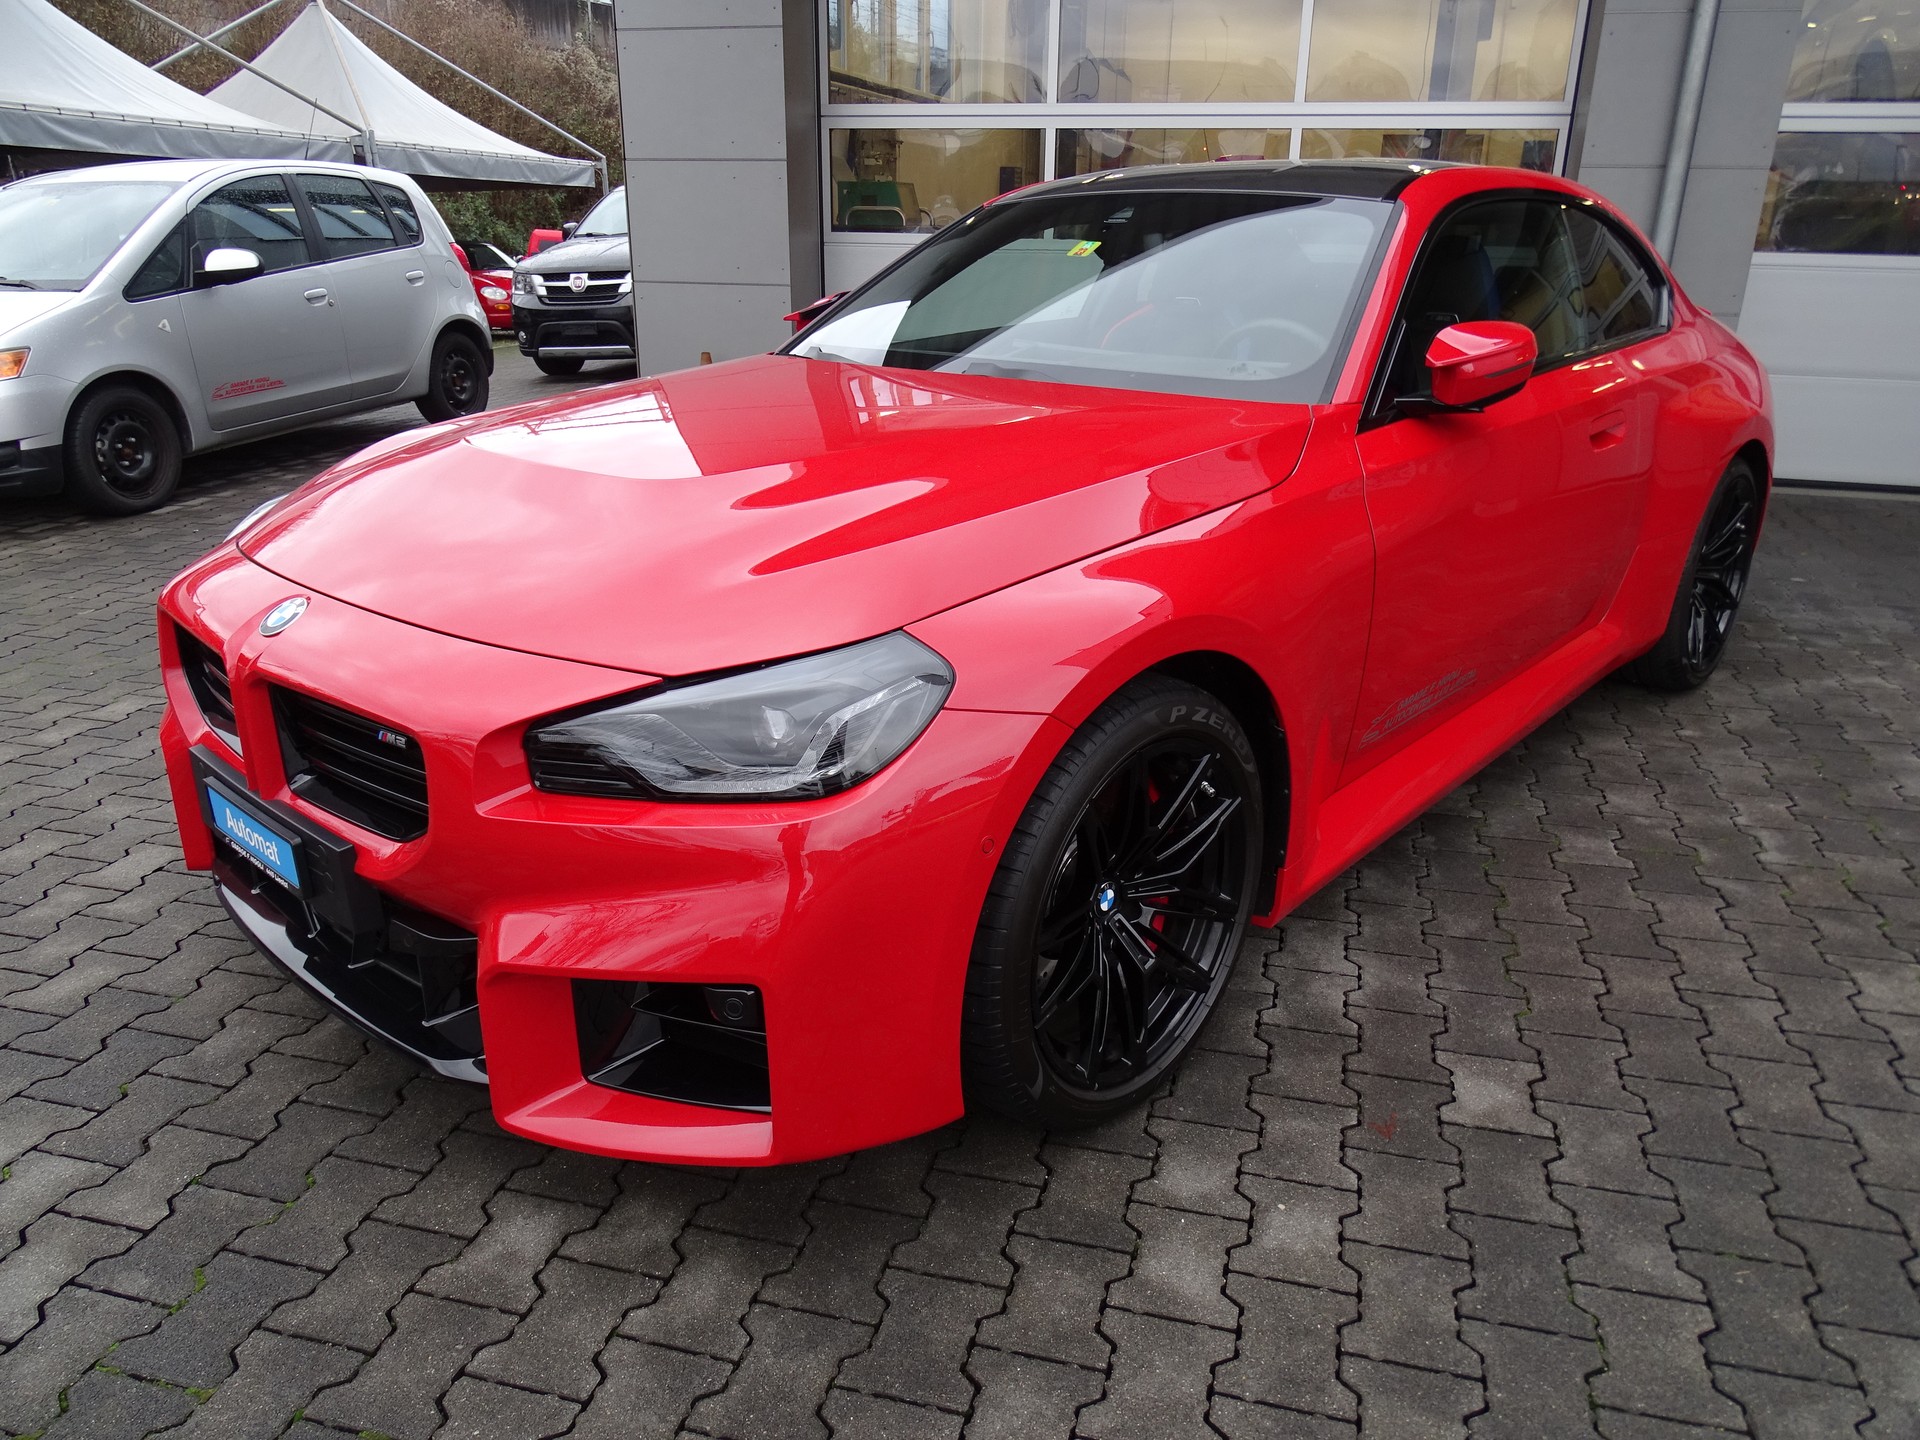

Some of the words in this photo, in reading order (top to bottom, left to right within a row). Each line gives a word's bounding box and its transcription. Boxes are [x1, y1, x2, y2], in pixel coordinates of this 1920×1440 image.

[1169, 705, 1187, 723] P
[1191, 706, 1250, 752] ZERO
[225, 807, 281, 866] Automat
